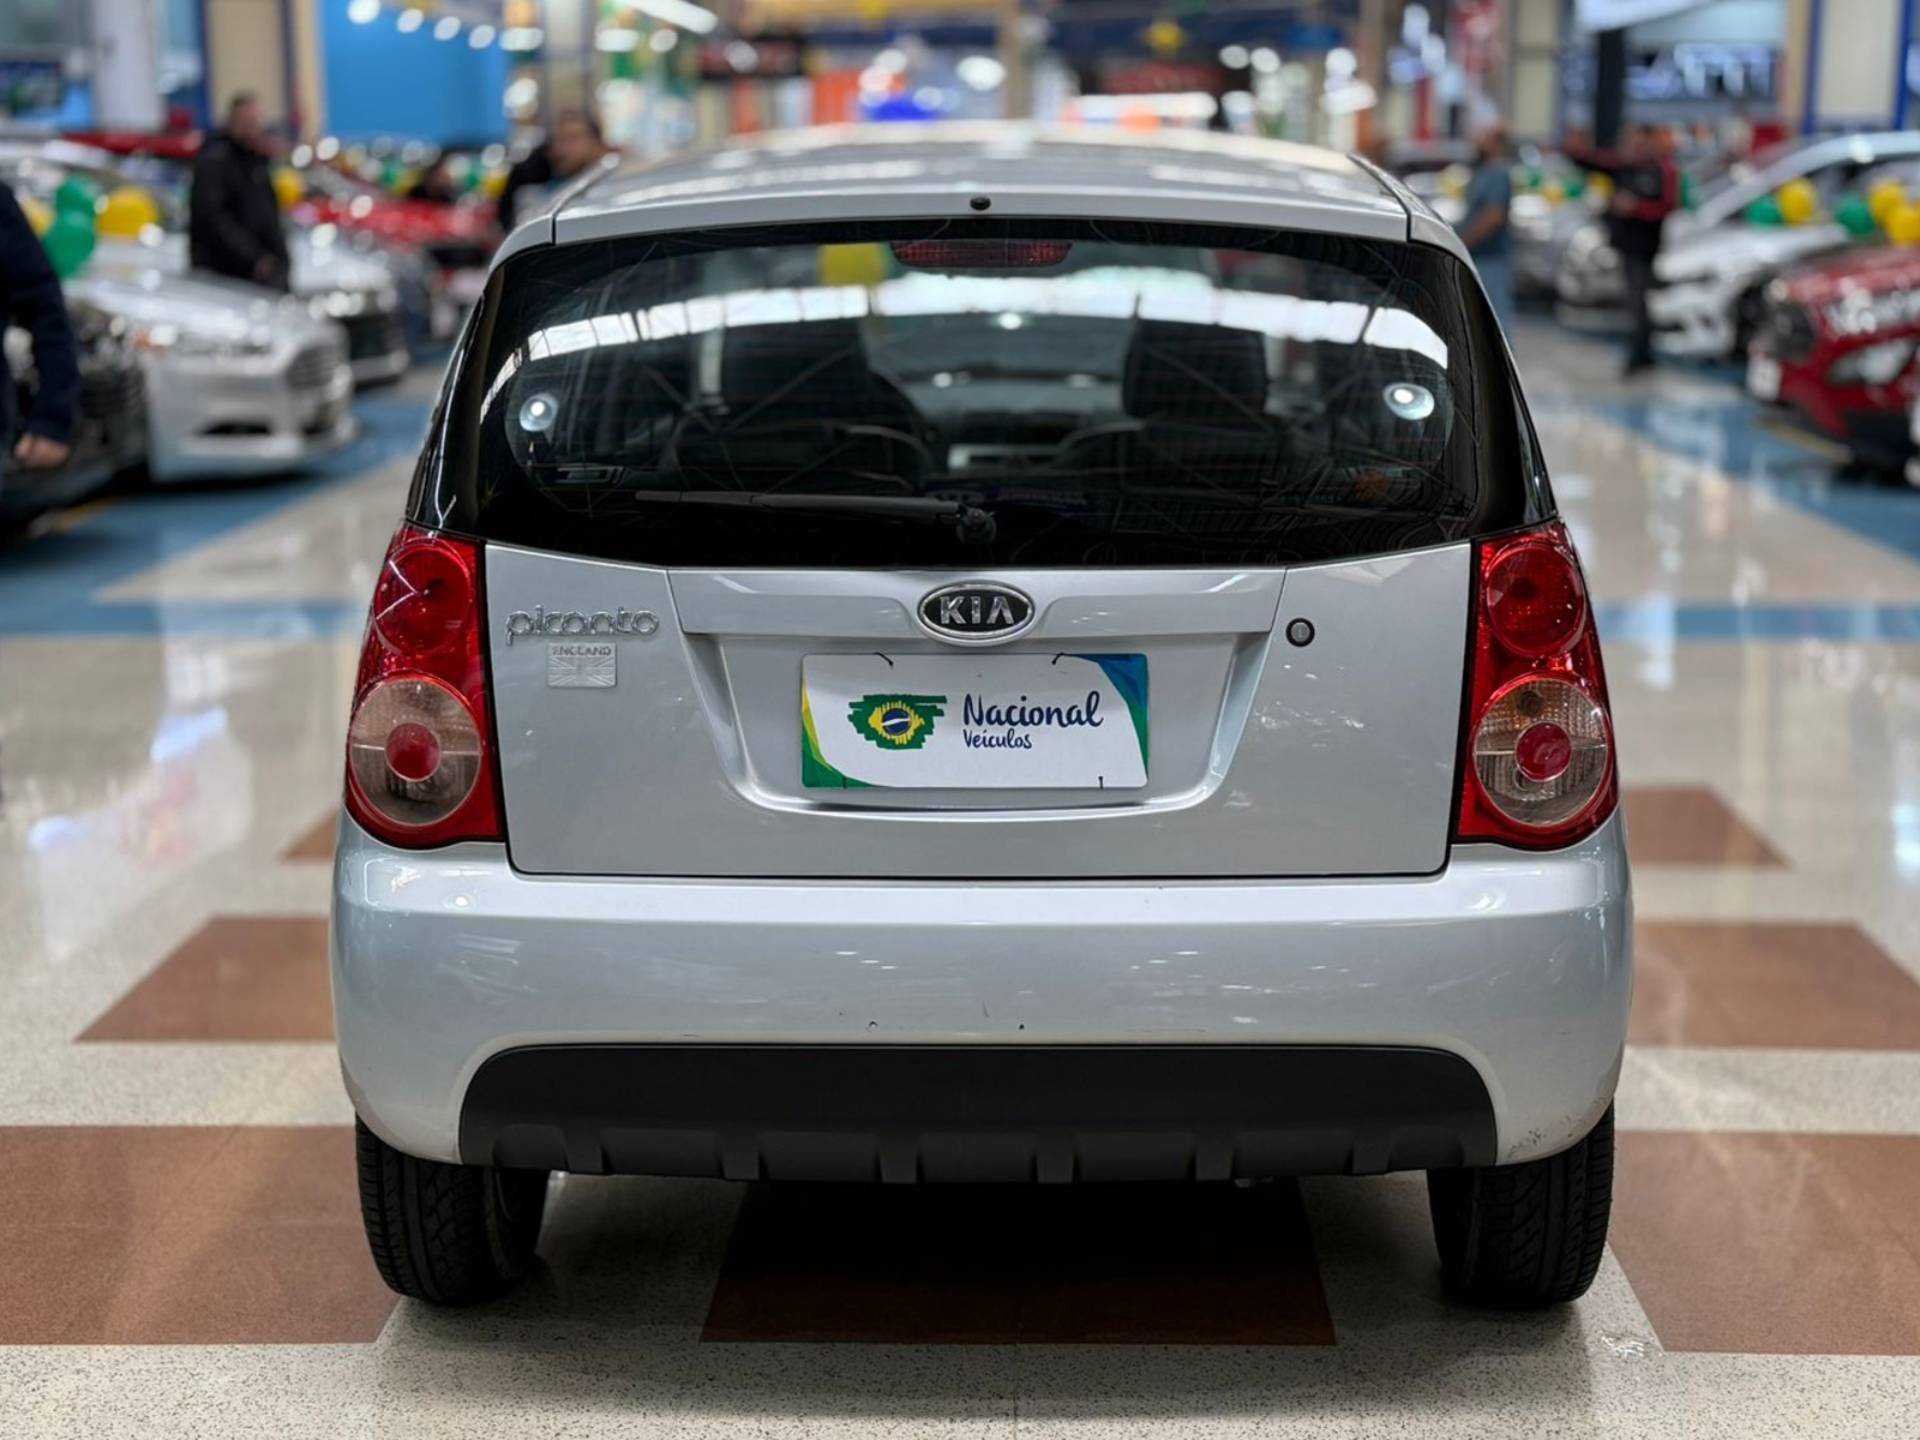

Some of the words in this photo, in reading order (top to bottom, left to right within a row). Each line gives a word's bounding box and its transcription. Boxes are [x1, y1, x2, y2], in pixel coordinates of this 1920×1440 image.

[506, 604, 659, 646] picanto
[939, 595, 1015, 625] KIA
[552, 645, 612, 656] ENGLAND
[963, 690, 1104, 728] Nacional
[963, 728, 1033, 749] Veículos
